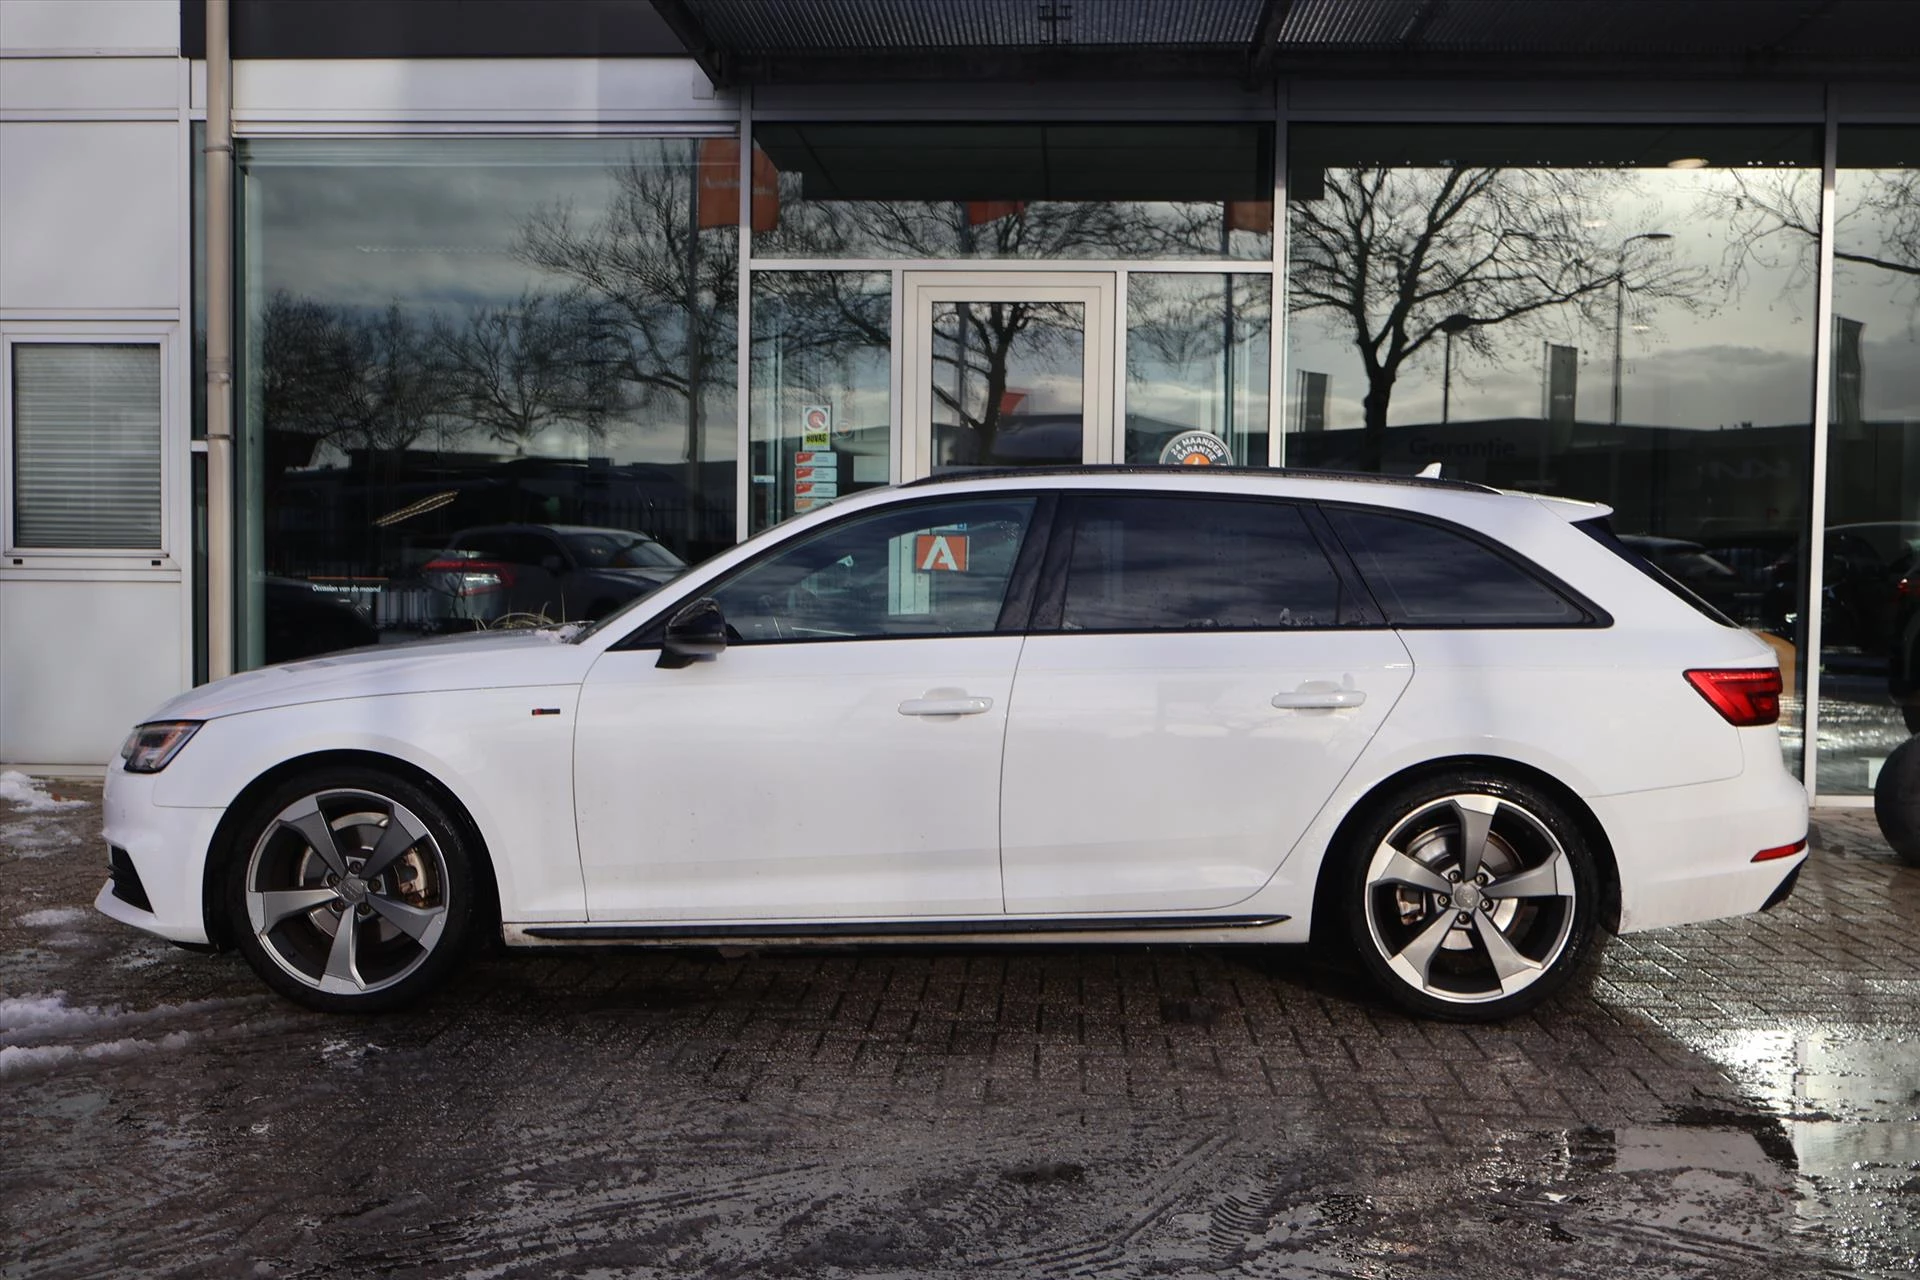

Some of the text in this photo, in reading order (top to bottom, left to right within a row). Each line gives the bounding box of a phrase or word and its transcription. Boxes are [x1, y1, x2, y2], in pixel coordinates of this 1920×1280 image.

[1170, 436, 1225, 458] 24 MAANDEN
[1176, 444, 1218, 462] GARANTIE
[1409, 437, 1517, 458] Garantie
[351, 584, 359, 593] de
[359, 584, 382, 593] maand
